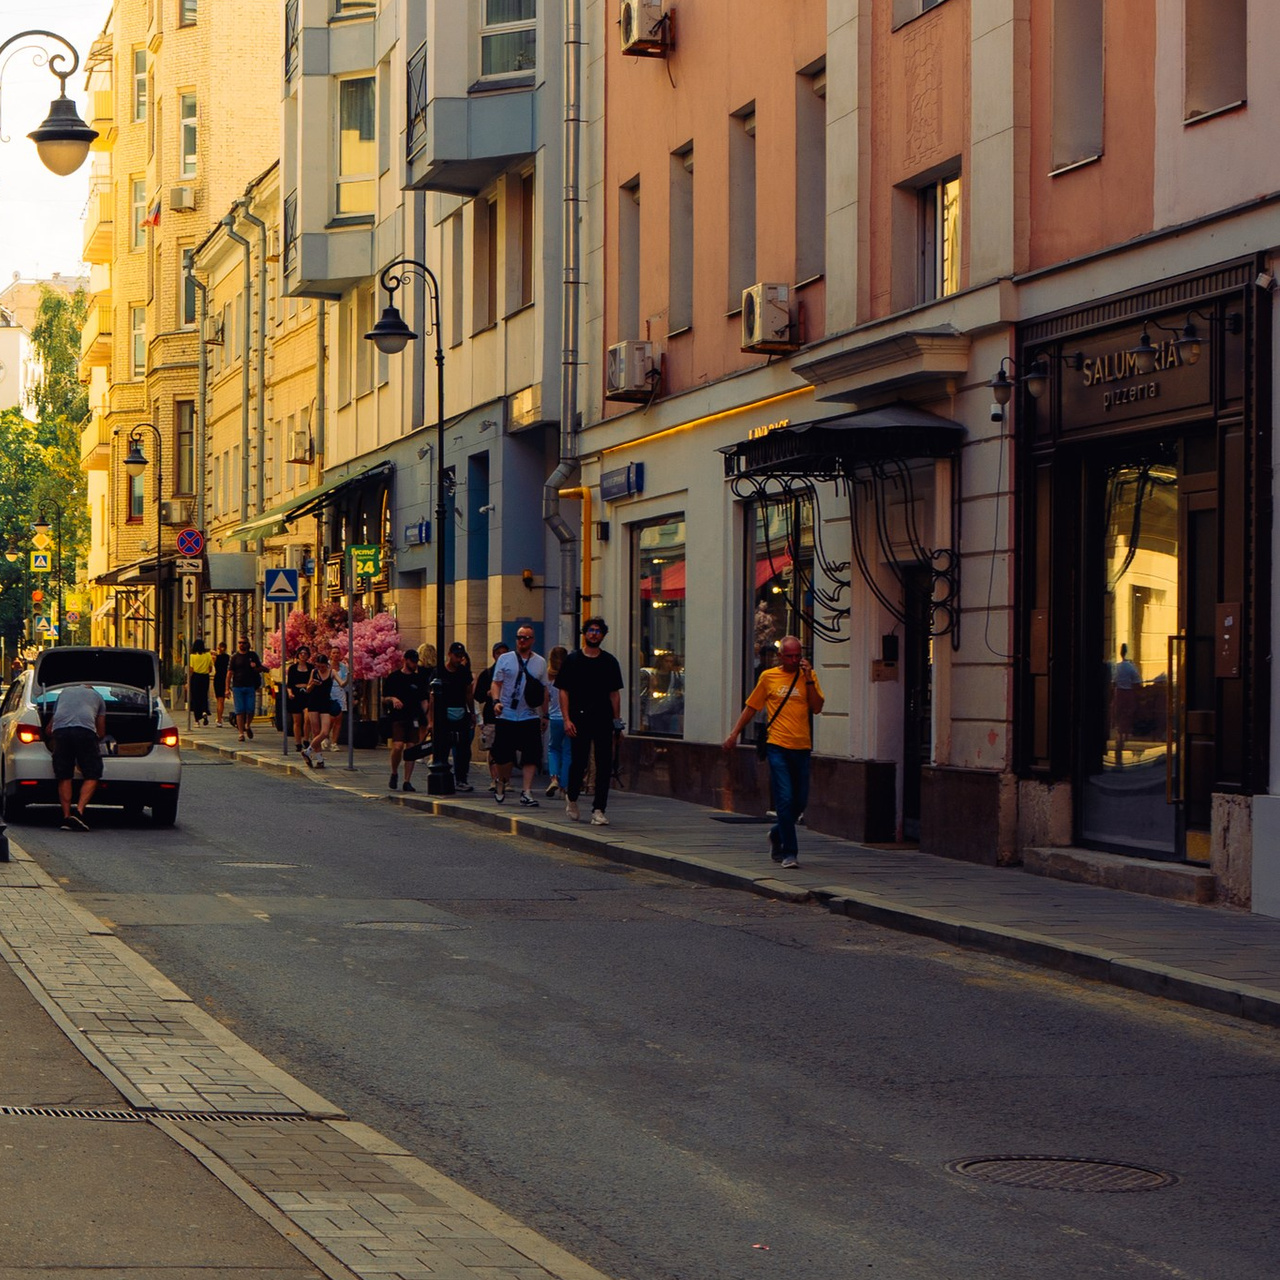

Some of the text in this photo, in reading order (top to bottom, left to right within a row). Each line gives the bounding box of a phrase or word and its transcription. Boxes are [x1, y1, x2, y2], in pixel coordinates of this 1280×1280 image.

[1082, 339, 1178, 387] SALUMRIA
[1103, 382, 1156, 408] pizzeria
[355, 561, 375, 574] 24
